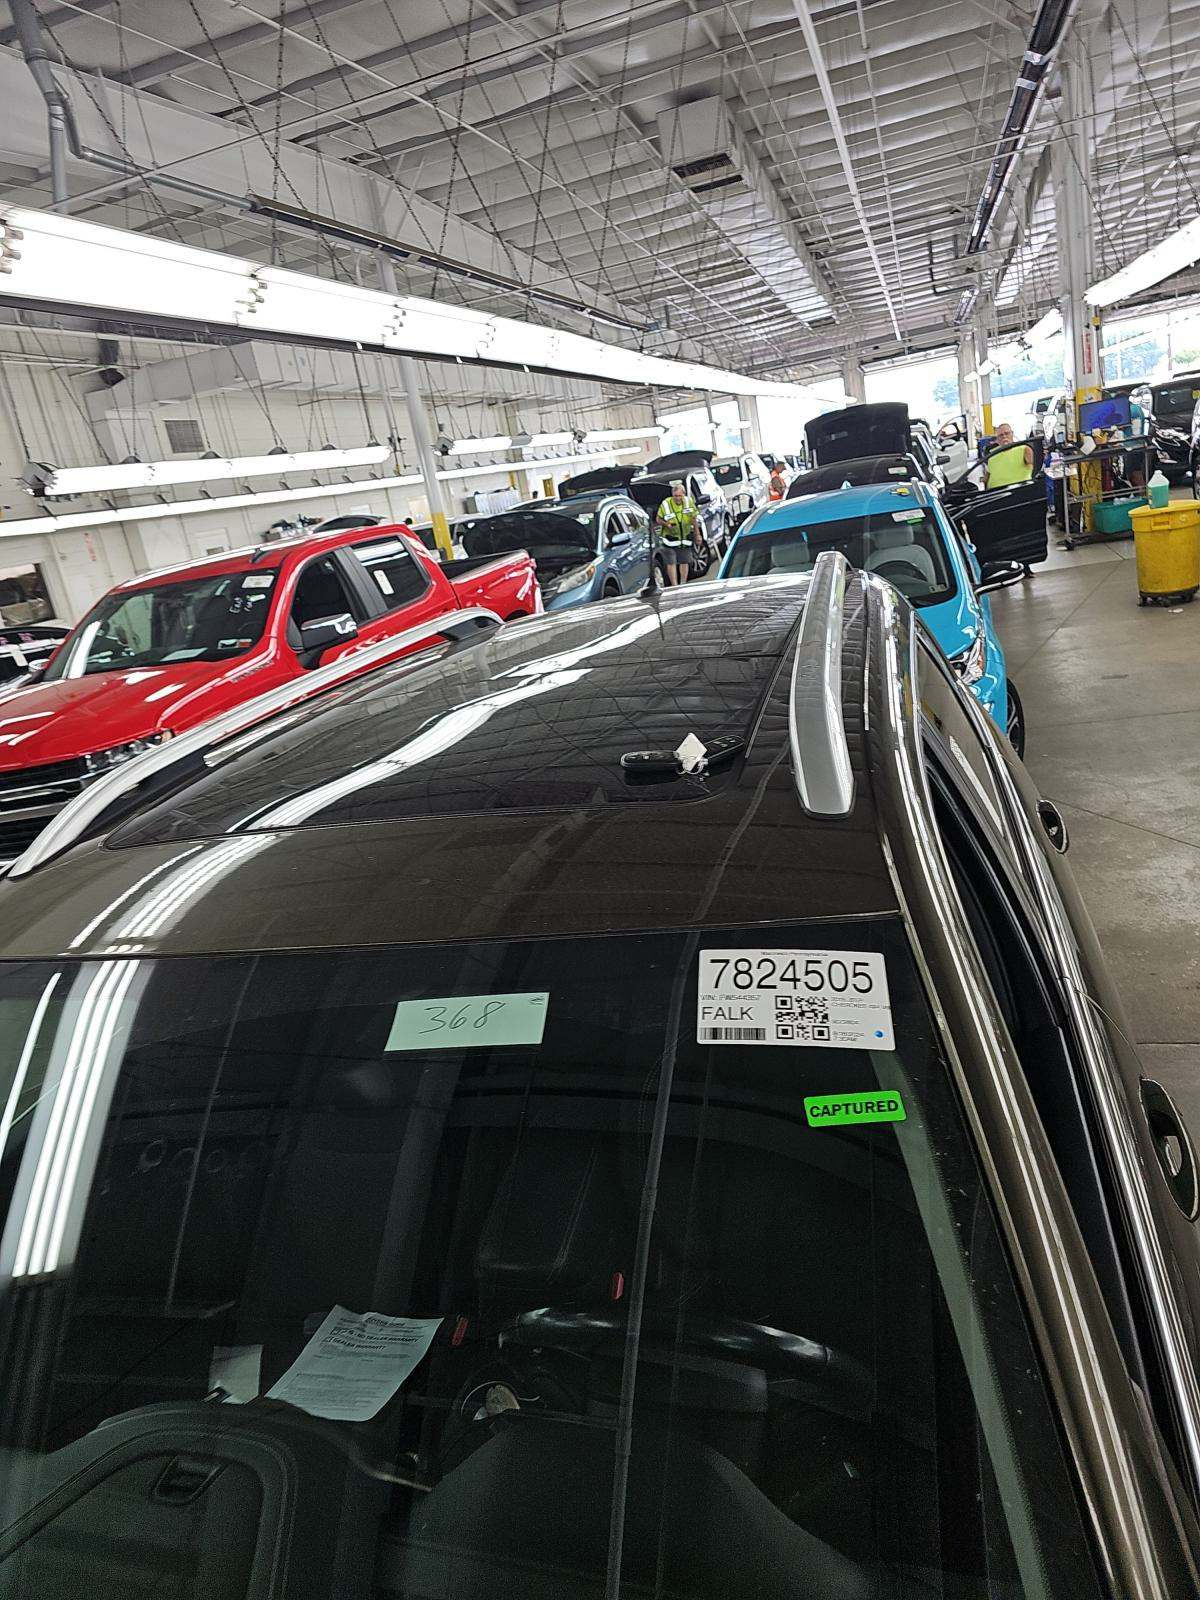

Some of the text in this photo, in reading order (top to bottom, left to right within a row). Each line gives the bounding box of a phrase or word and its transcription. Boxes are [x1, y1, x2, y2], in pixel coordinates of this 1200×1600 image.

[709, 958, 874, 994] 7824505
[419, 1001, 506, 1034] 368
[701, 1006, 754, 1020] FALK
[809, 1099, 899, 1118] CAPTURED
